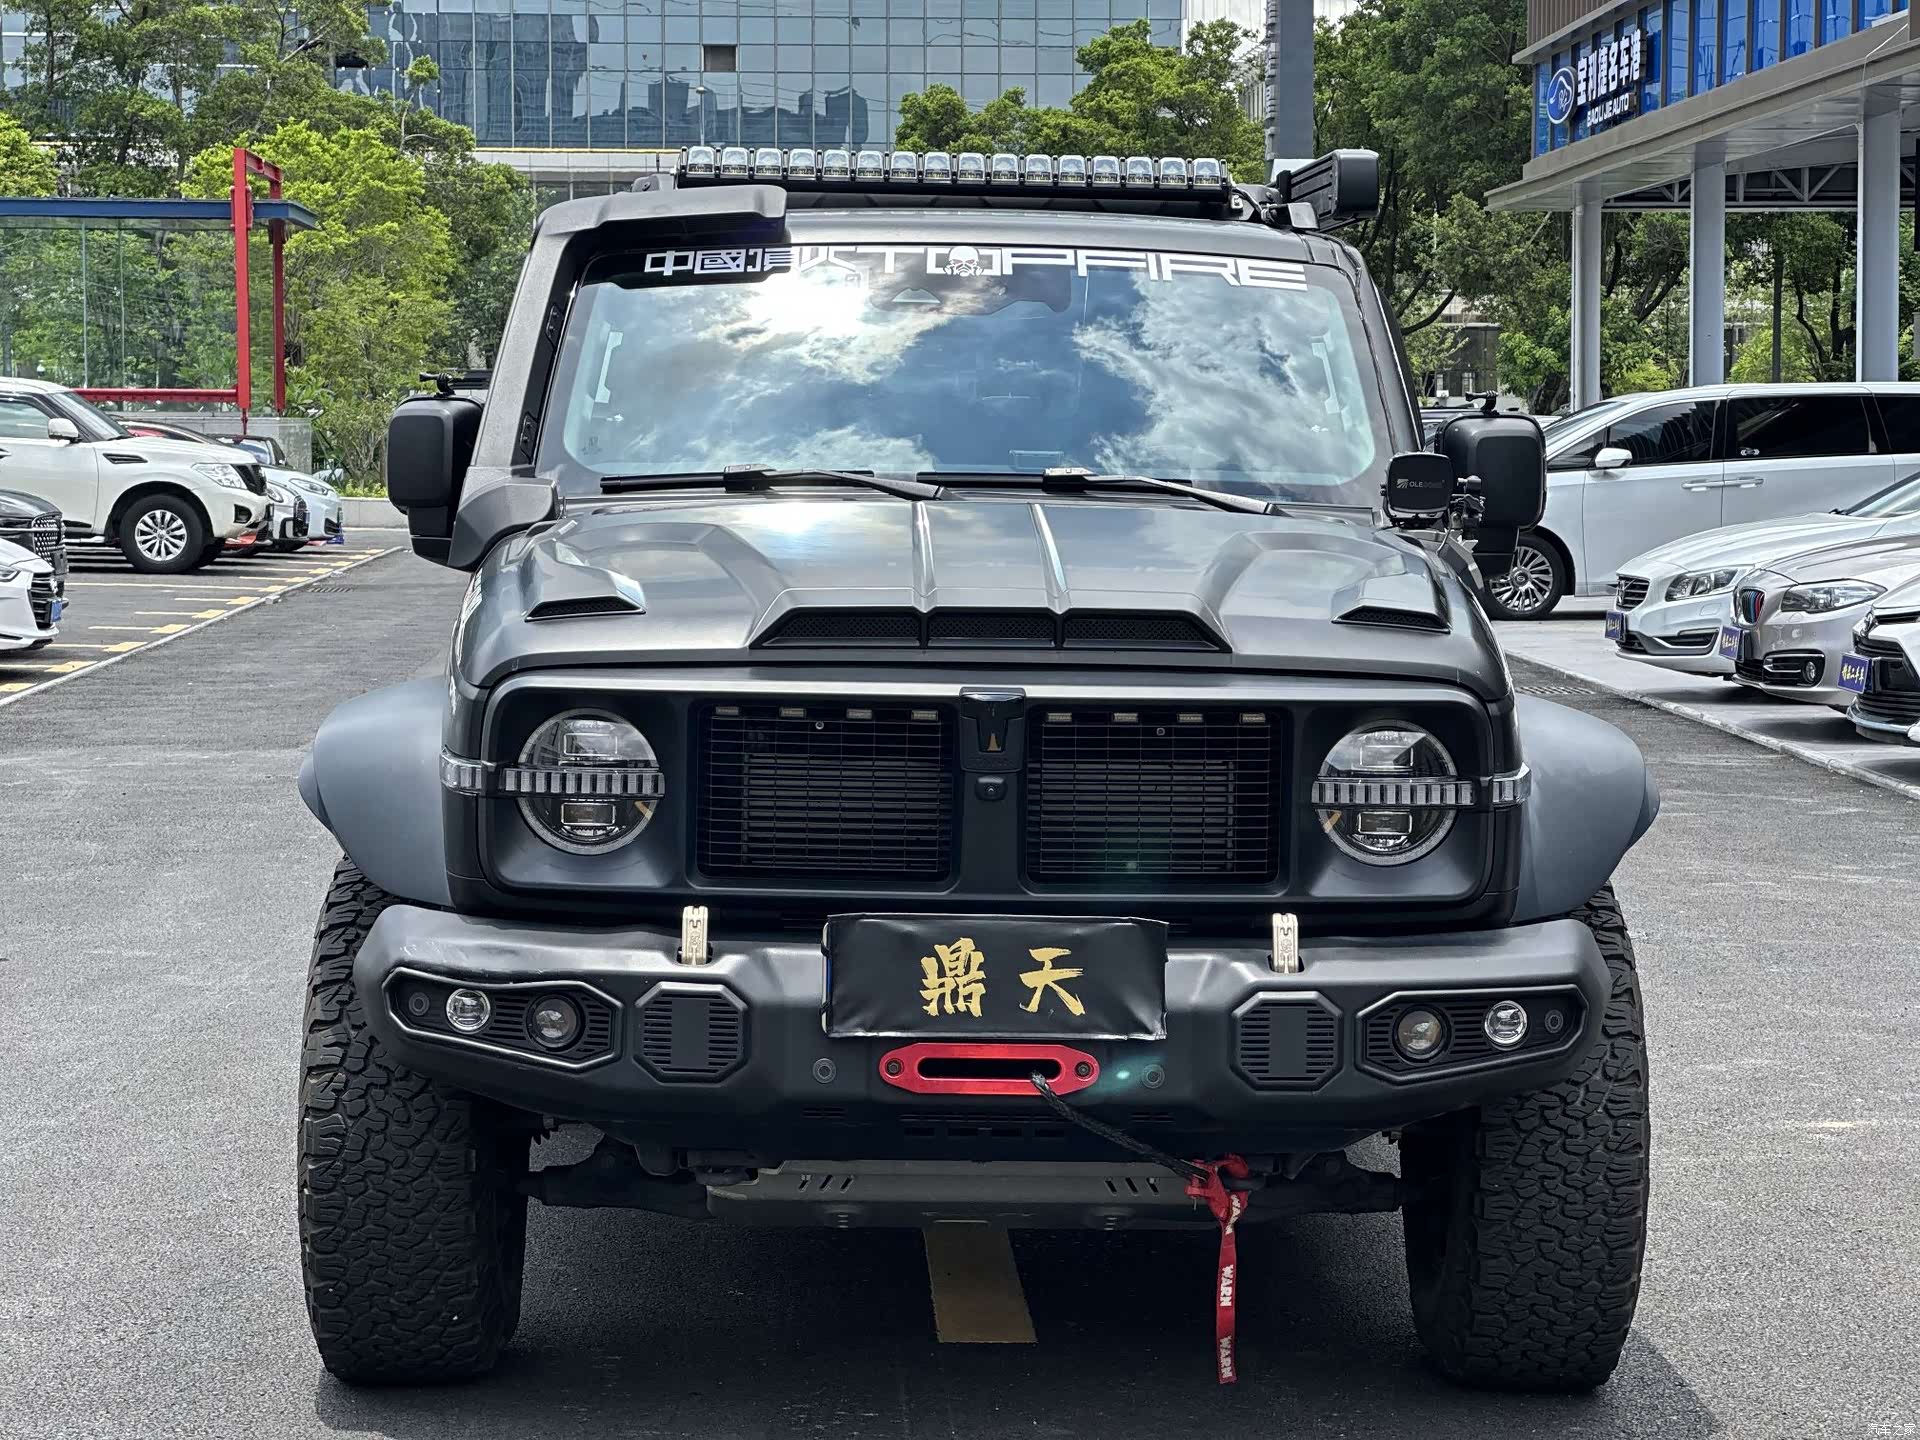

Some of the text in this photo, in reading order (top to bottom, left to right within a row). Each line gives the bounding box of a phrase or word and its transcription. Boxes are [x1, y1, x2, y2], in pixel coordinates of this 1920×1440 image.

[1577, 29, 1641, 106] 宝利捷名车港
[920, 937, 1086, 1017] 鼎天
[1219, 1264, 1234, 1307] WARN
[1218, 1335, 1233, 1379] WARN
